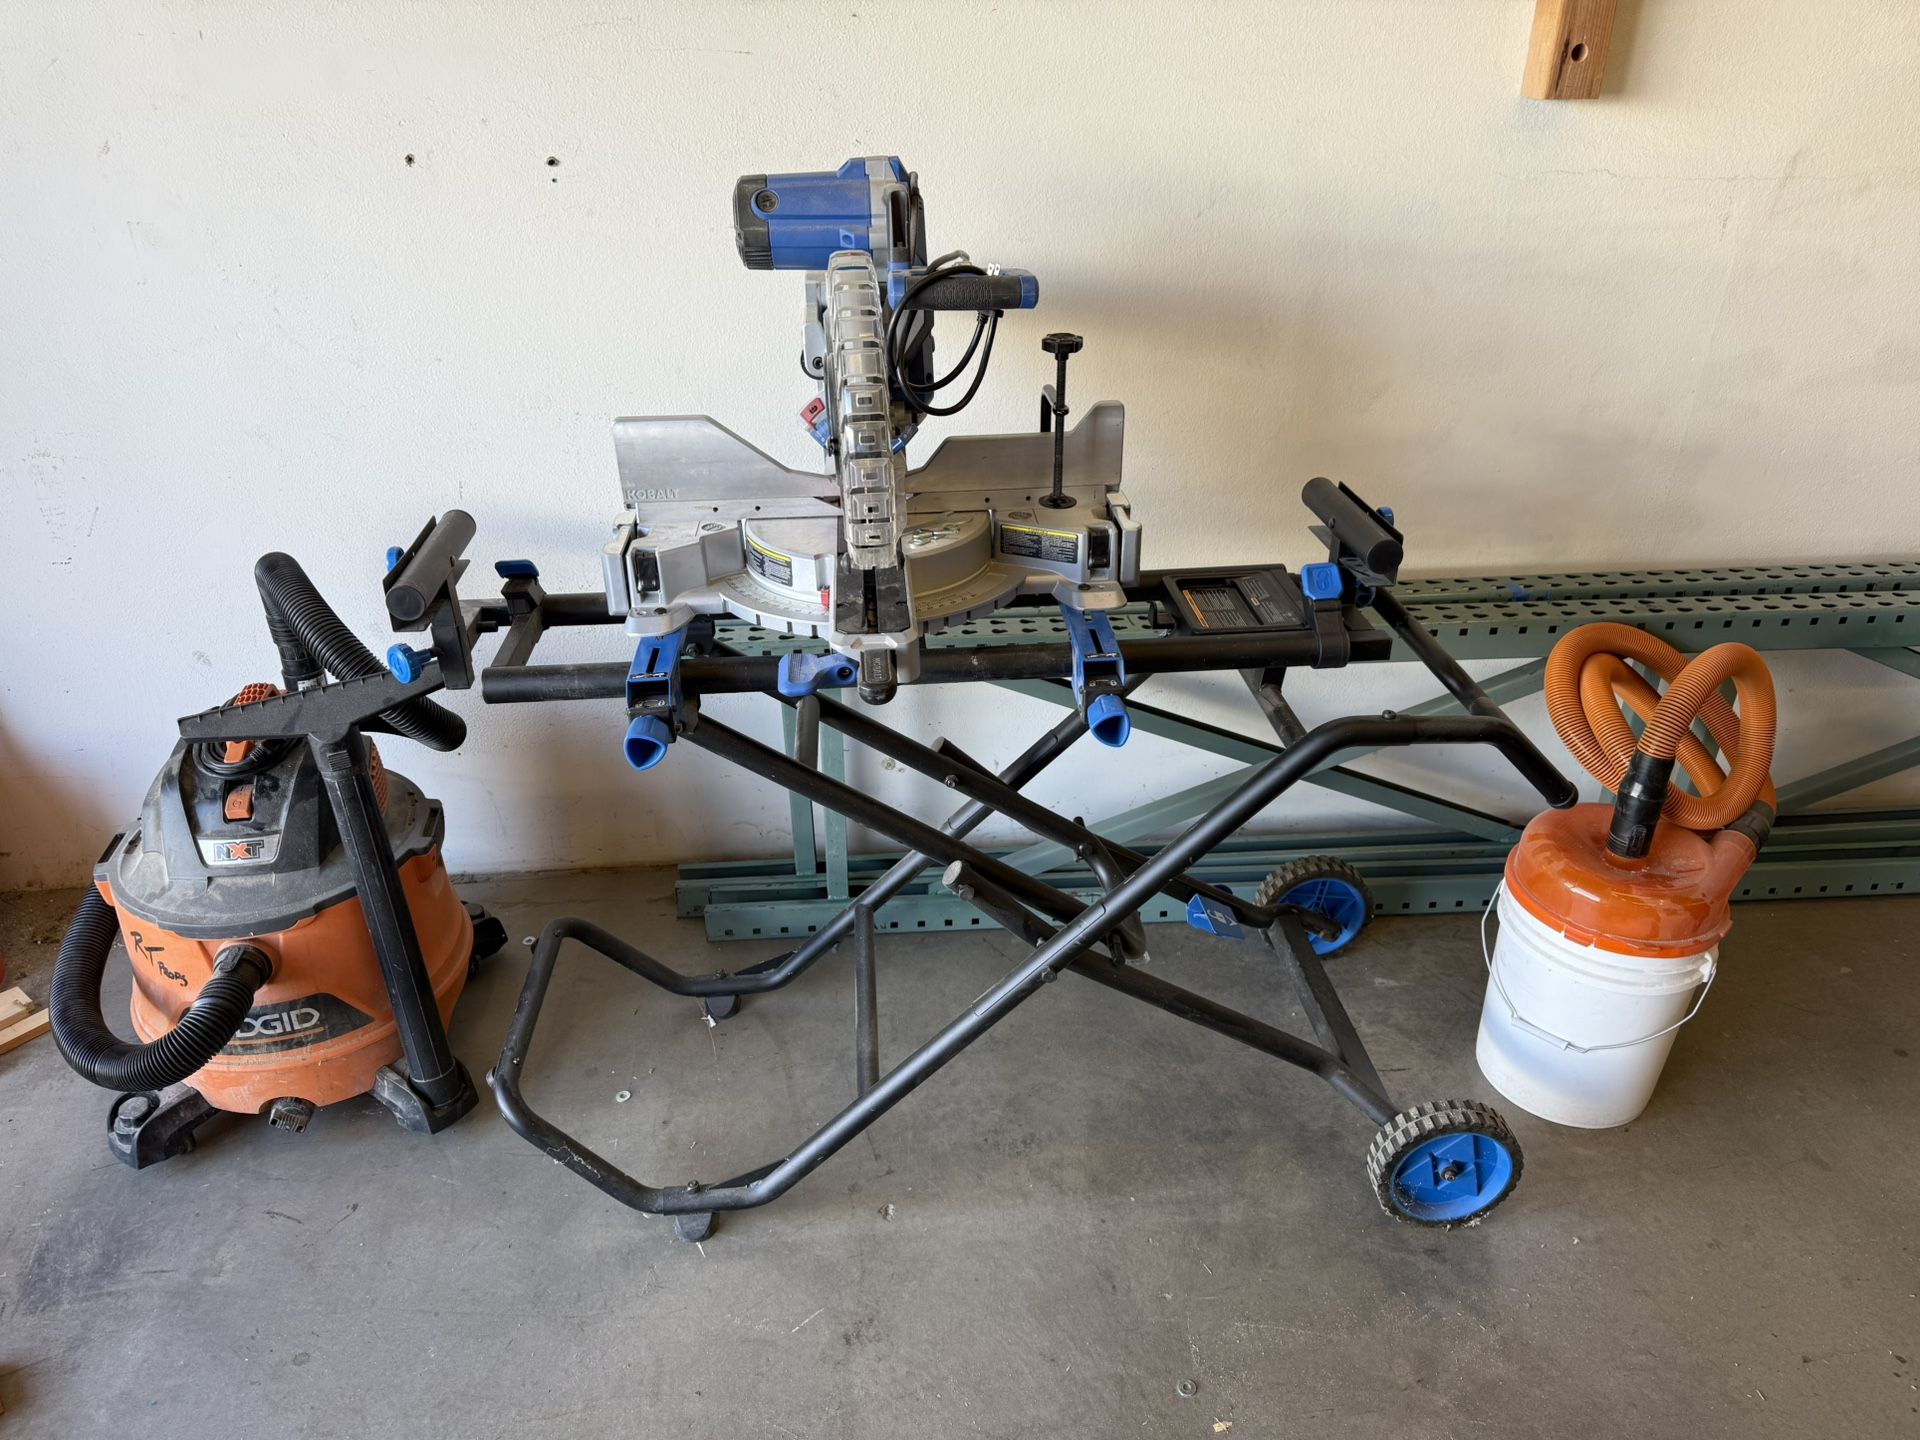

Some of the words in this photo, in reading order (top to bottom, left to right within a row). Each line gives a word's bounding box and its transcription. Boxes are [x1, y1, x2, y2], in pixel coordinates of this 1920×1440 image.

[624, 488, 680, 500] KOBALT
[214, 840, 265, 861] NXT
[235, 1007, 320, 1038] DGID
